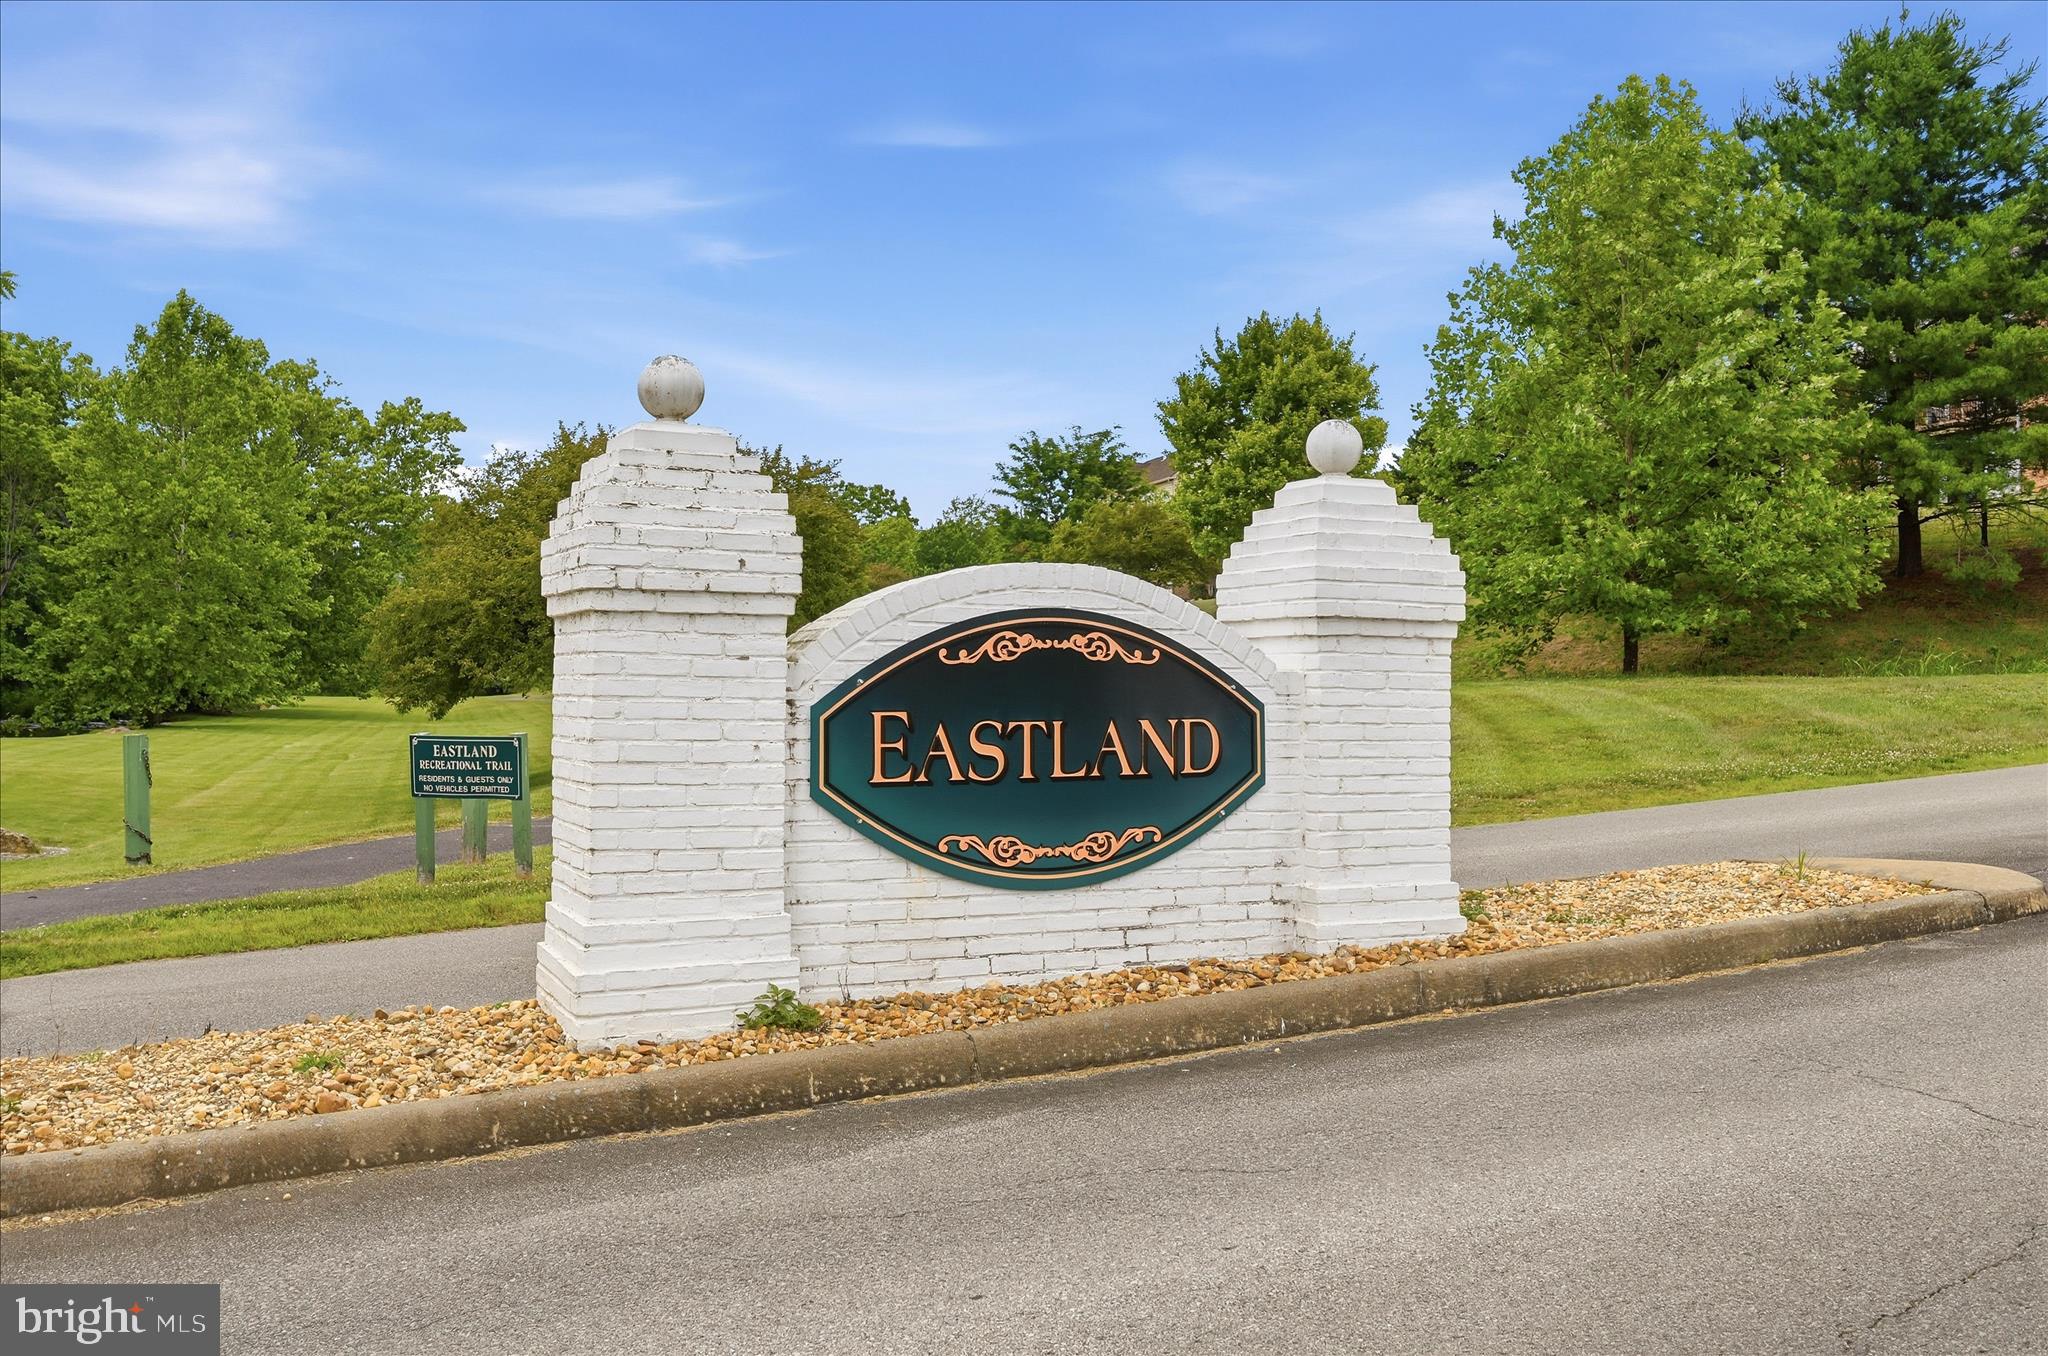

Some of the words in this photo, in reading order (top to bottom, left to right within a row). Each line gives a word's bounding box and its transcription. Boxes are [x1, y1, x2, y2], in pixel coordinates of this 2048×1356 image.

[433, 744, 497, 758] EASTLAND
[869, 711, 1222, 784] EASTLAND
[419, 760, 482, 770] RECREATIONAL
[485, 761, 512, 771] TRAIL
[418, 775, 455, 783] RESIDENTS
[497, 776, 513, 784] ONLY
[423, 784, 433, 792] NO
[470, 785, 510, 793] PERMITTED
